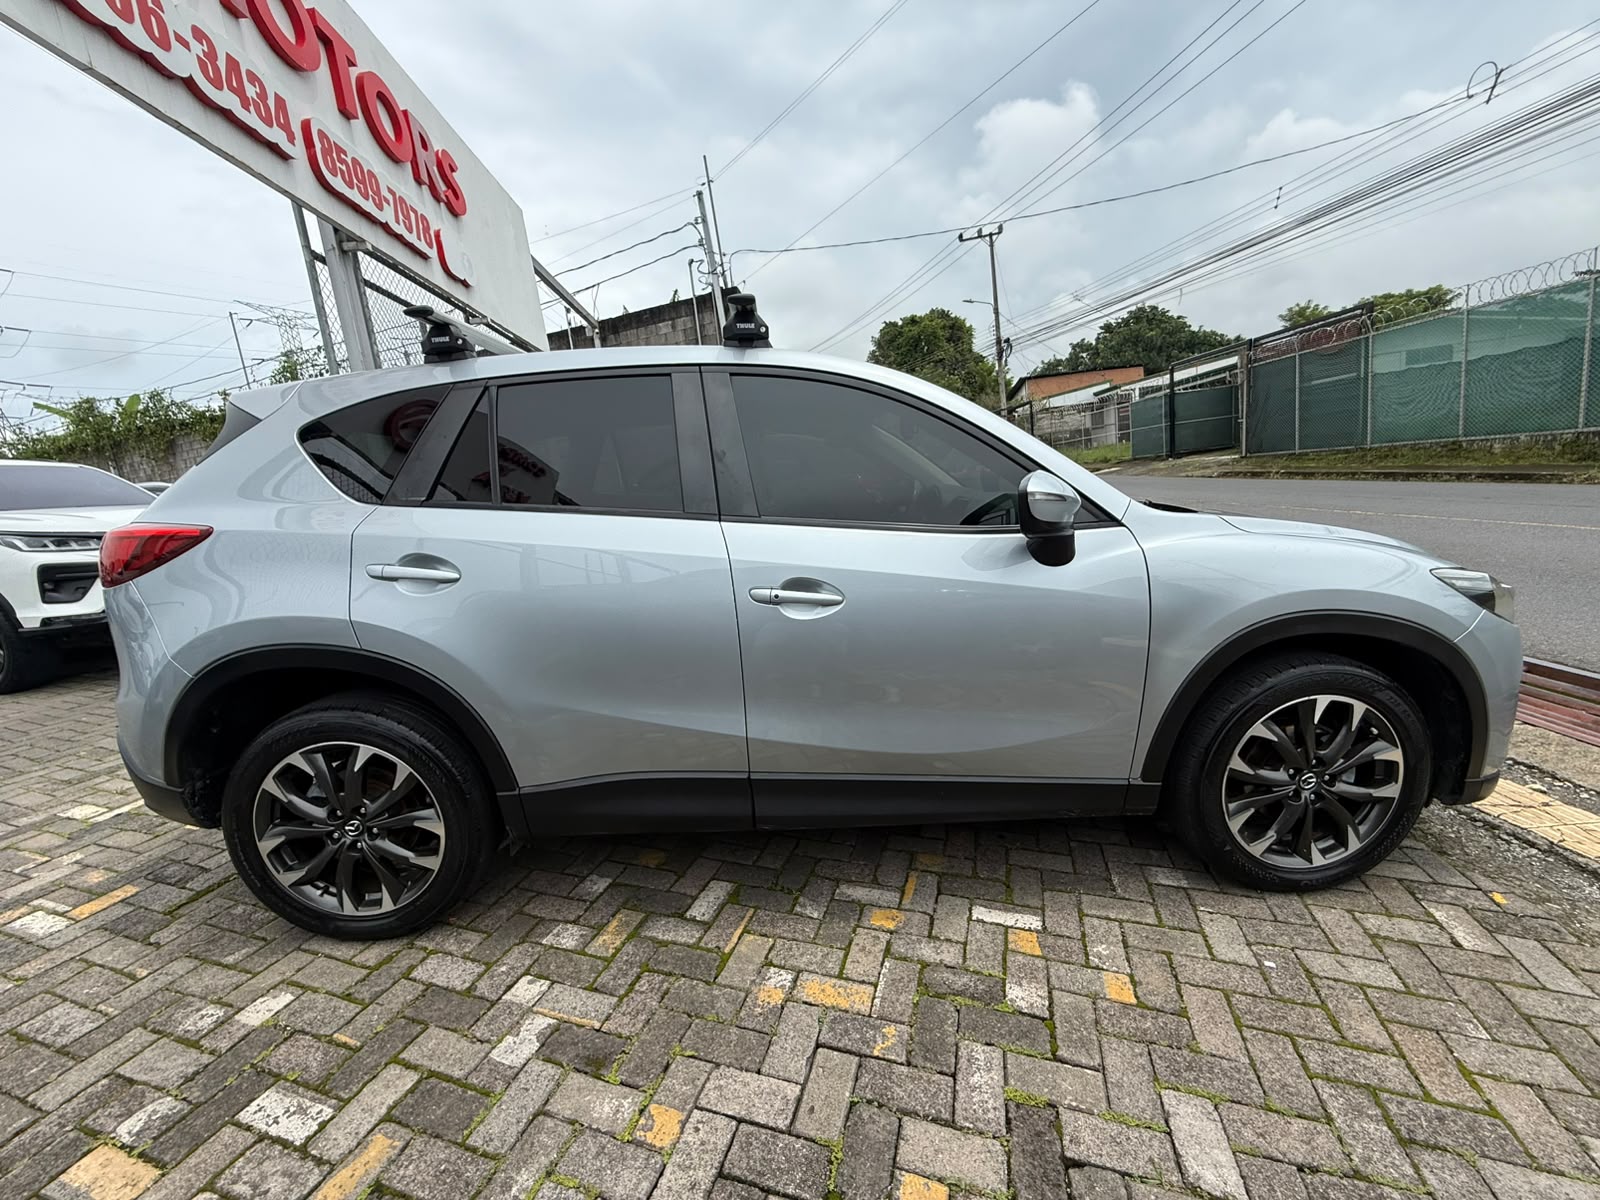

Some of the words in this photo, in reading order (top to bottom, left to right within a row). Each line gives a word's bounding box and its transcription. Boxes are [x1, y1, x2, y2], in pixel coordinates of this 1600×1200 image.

[104, 0, 296, 147] 6-3434
[219, 0, 467, 217] OTORS
[317, 128, 434, 250] 8599-7978
[431, 335, 450, 343] THULE
